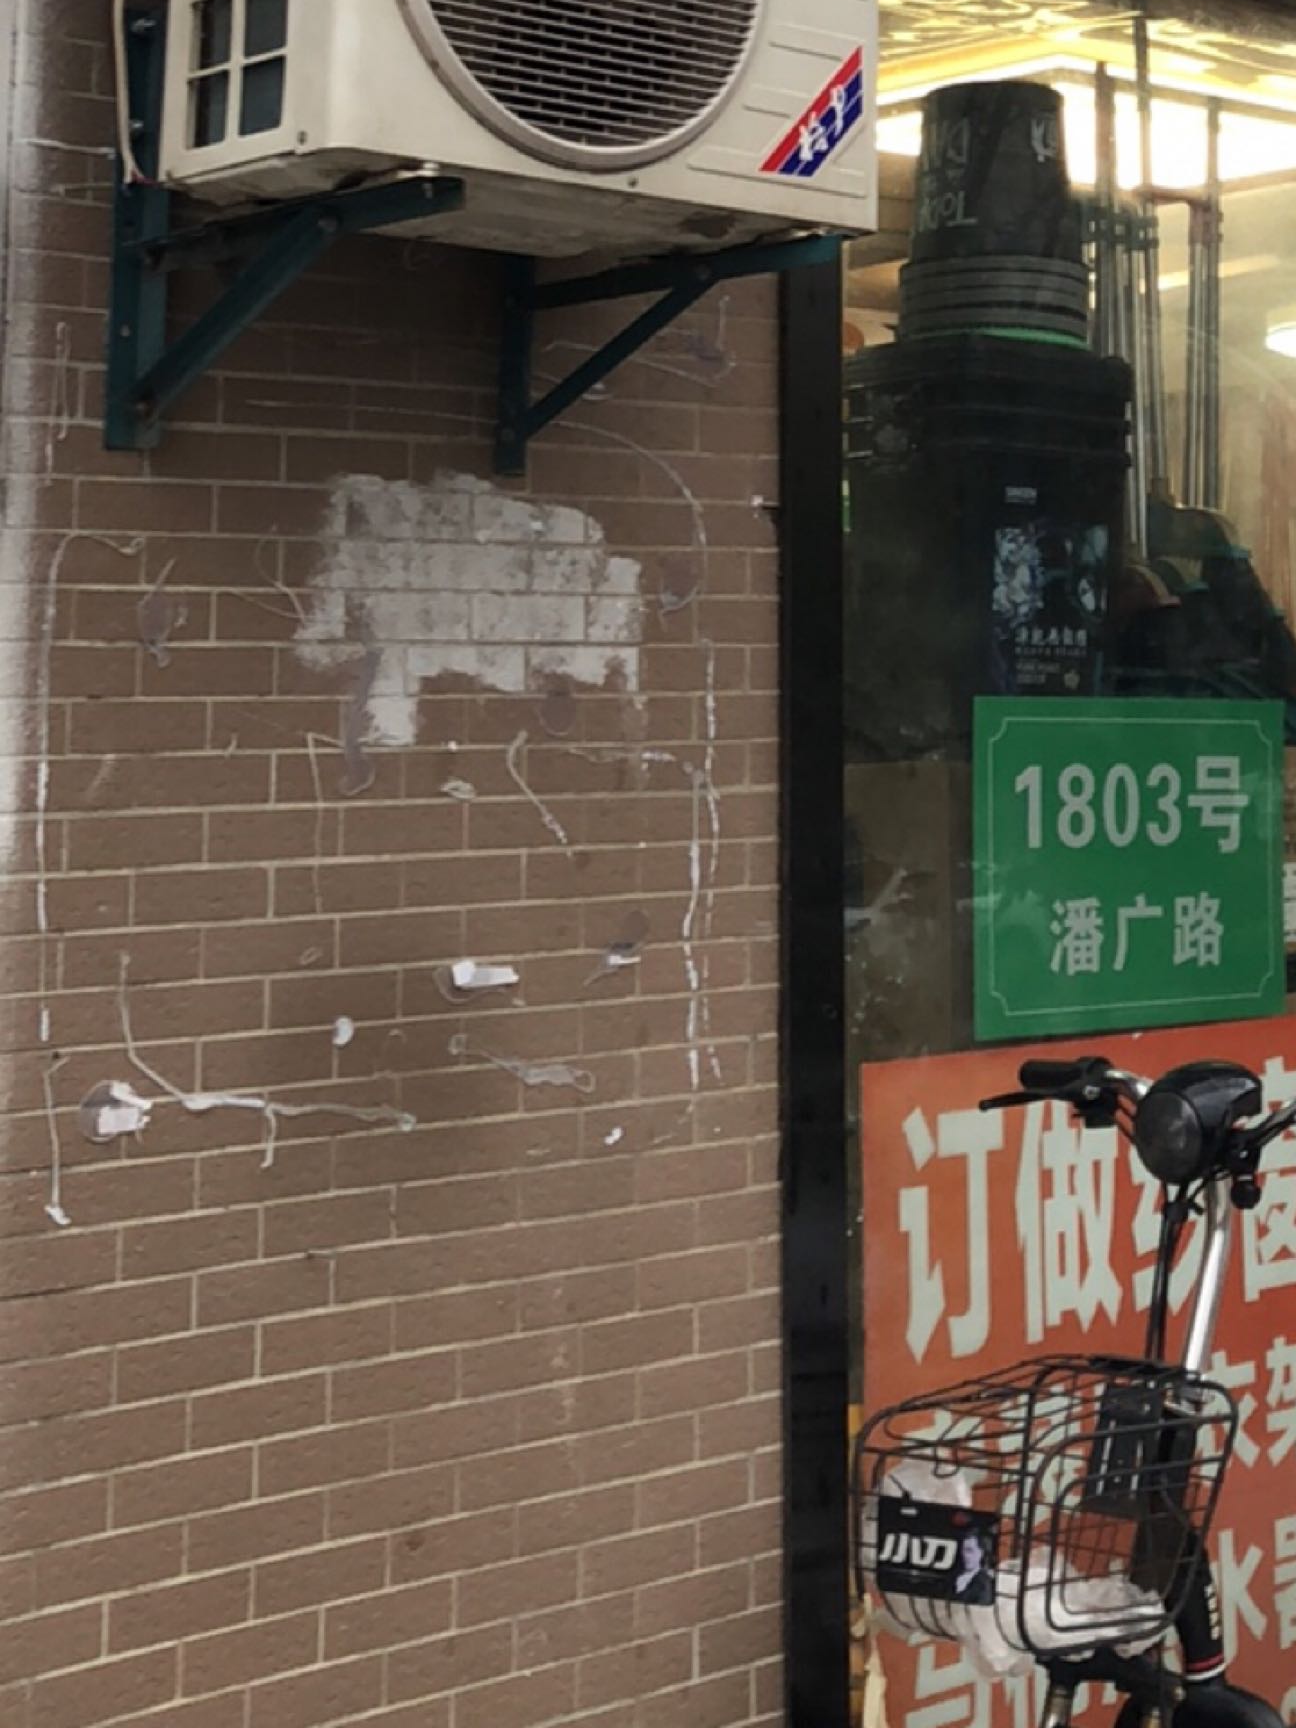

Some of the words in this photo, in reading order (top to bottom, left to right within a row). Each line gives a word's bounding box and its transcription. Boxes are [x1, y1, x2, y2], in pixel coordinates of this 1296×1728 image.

[1013, 755, 1251, 855] 1803号
[1049, 891, 1225, 977] 潘广路
